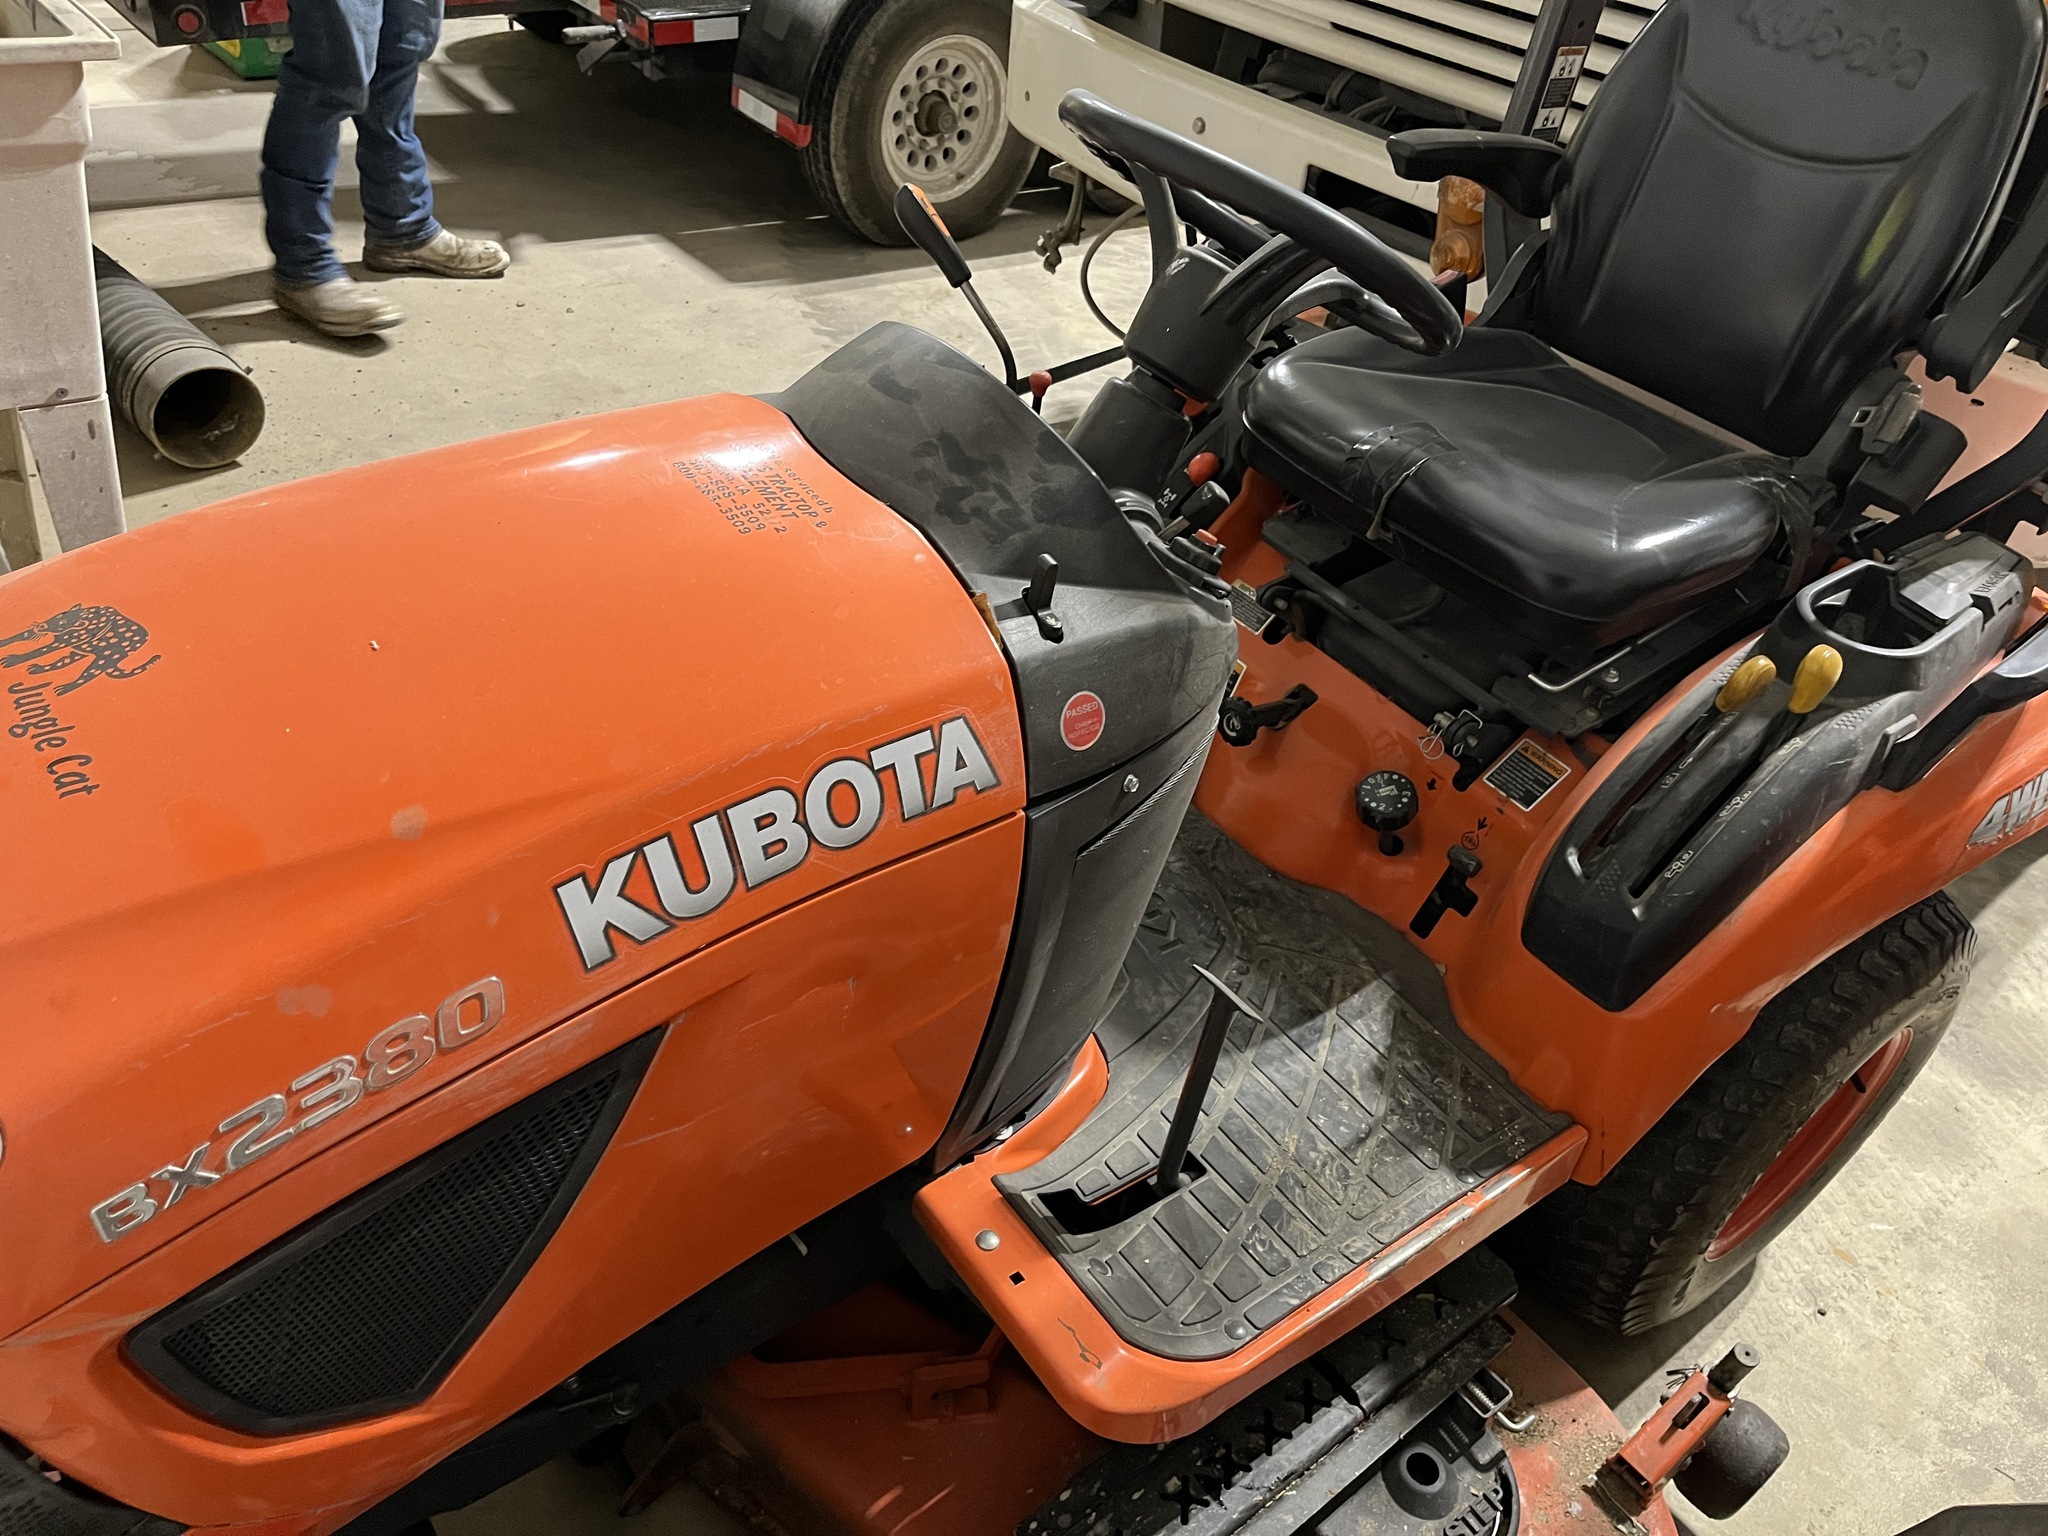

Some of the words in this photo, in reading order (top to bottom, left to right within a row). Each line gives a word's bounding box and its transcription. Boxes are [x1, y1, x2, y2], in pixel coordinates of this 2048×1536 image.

[7, 681, 76, 752] Jungle
[46, 754, 100, 800] Cat
[1066, 701, 1099, 719] PASSED
[1530, 750, 1563, 776] WARNING
[554, 715, 1001, 969] KUBOTA
[91, 975, 506, 1244] BX2380
